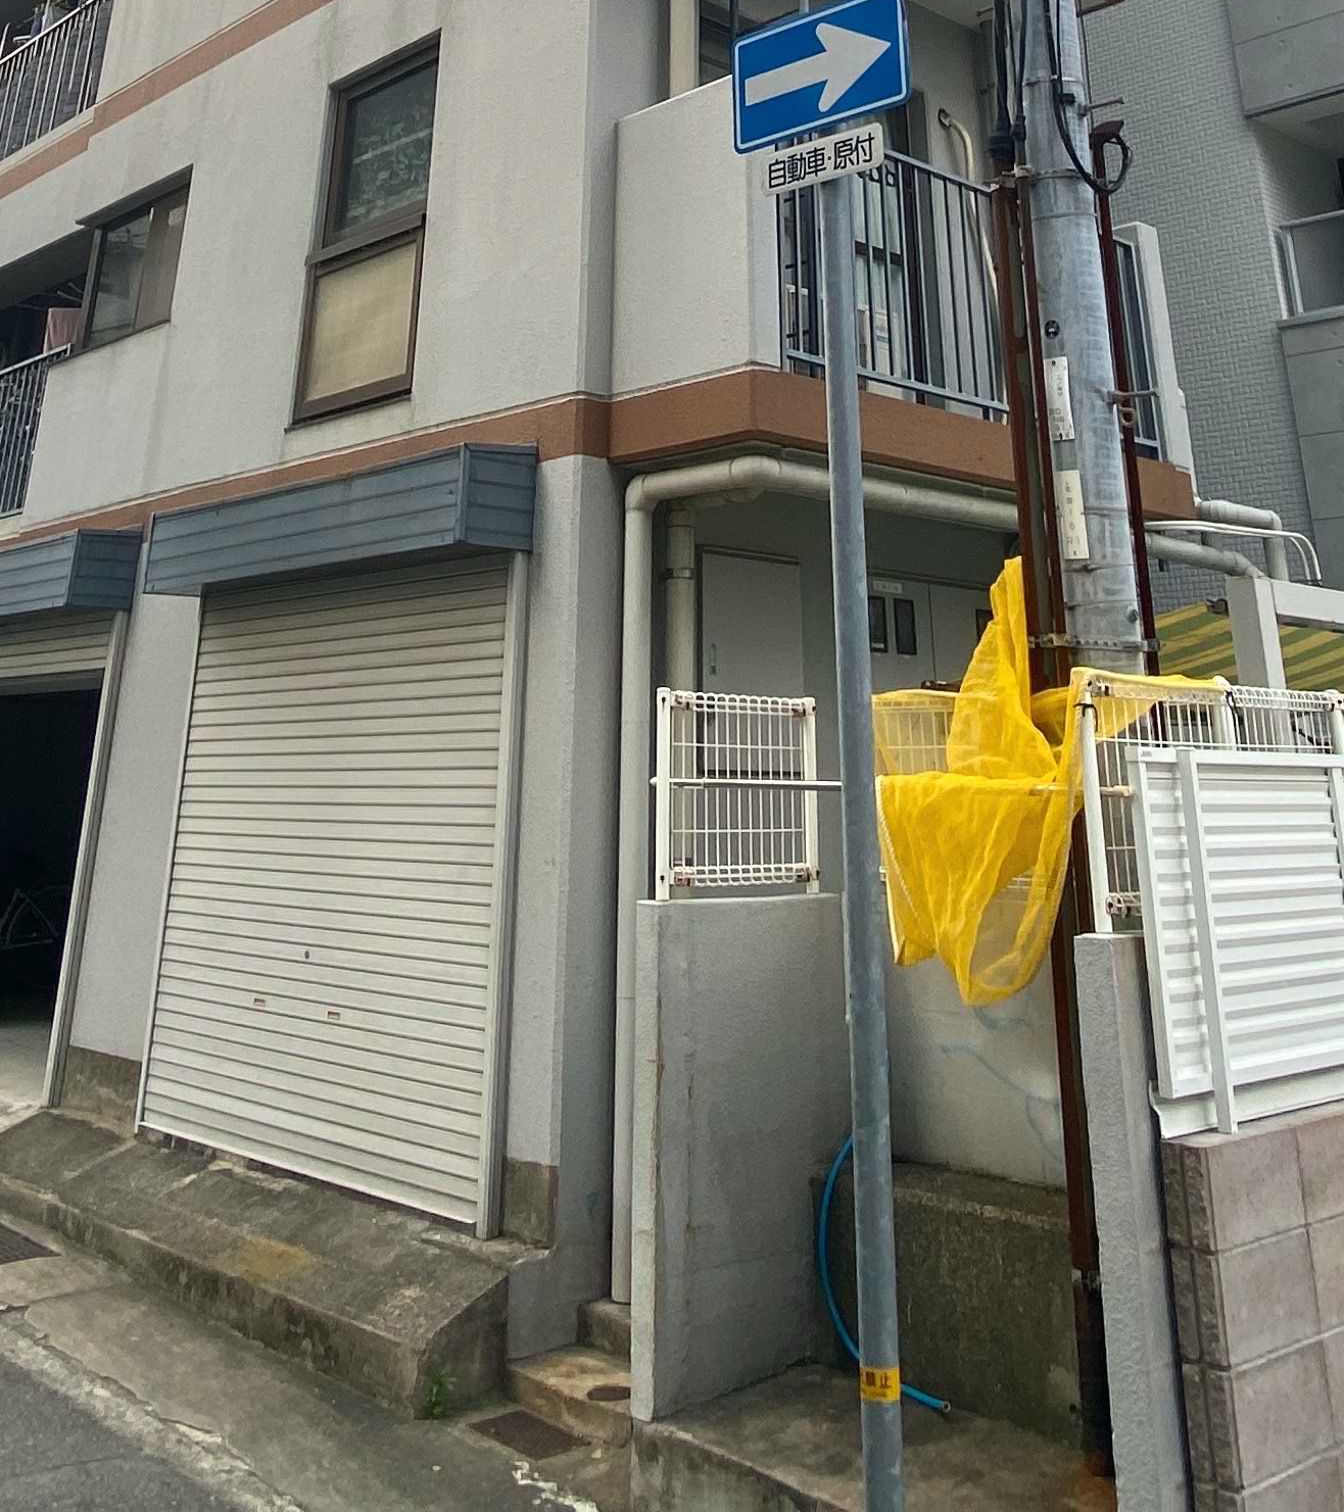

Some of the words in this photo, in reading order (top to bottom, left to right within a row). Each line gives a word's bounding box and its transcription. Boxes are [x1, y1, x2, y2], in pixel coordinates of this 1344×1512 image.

[768, 131, 875, 189] 自動車・原付
